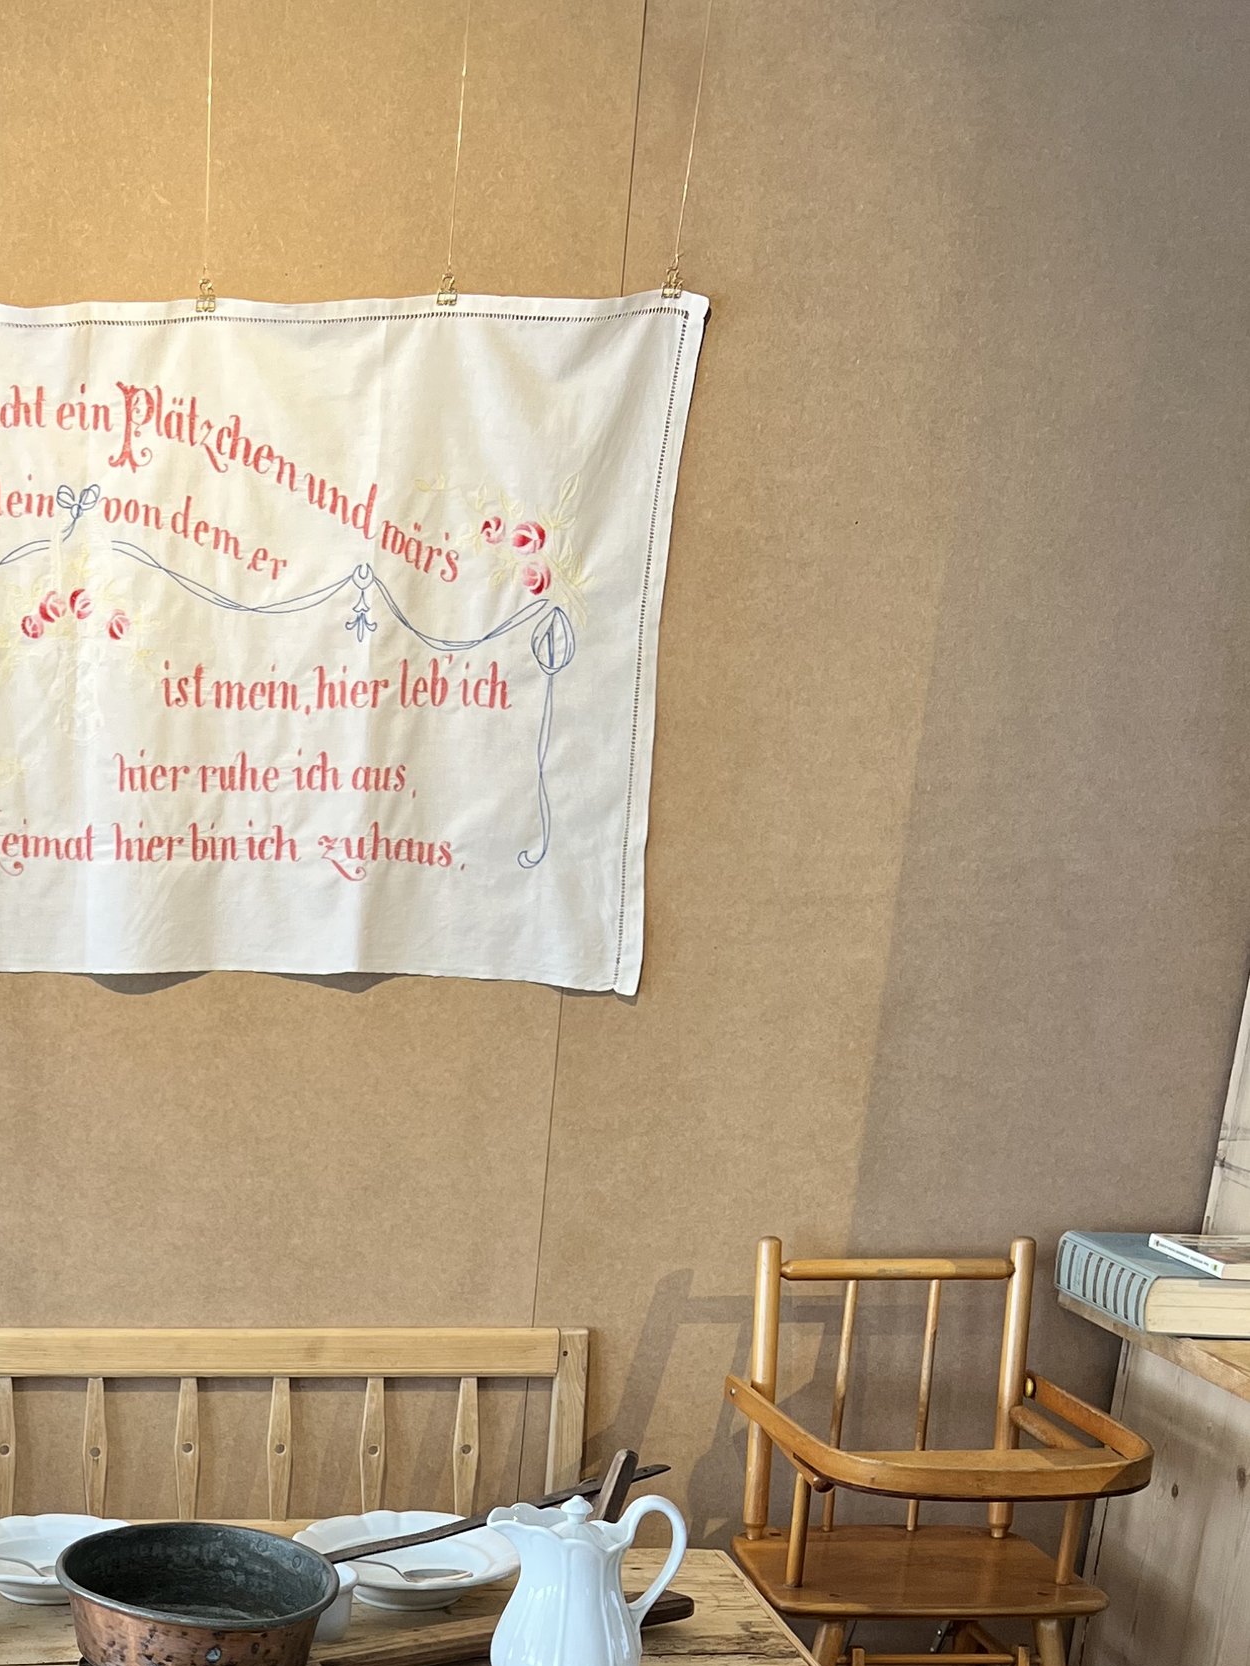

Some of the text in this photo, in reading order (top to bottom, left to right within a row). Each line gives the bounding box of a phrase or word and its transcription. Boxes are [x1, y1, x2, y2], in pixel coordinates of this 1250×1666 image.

[56, 383, 114, 432] ein
[108, 380, 298, 493] Plätzchen
[304, 472, 378, 540] und
[381, 519, 460, 583] wär's
[100, 497, 164, 530] von
[249, 547, 287, 580] er
[161, 659, 206, 709] ist
[212, 664, 311, 716] mein,
[313, 664, 390, 711] hier
[459, 660, 512, 711] ich
[113, 749, 190, 793] hier
[197, 750, 280, 794] ruhe
[291, 748, 344, 792] ich
[112, 820, 185, 863] hier
[187, 820, 238, 863] bin
[245, 820, 302, 862] ich
